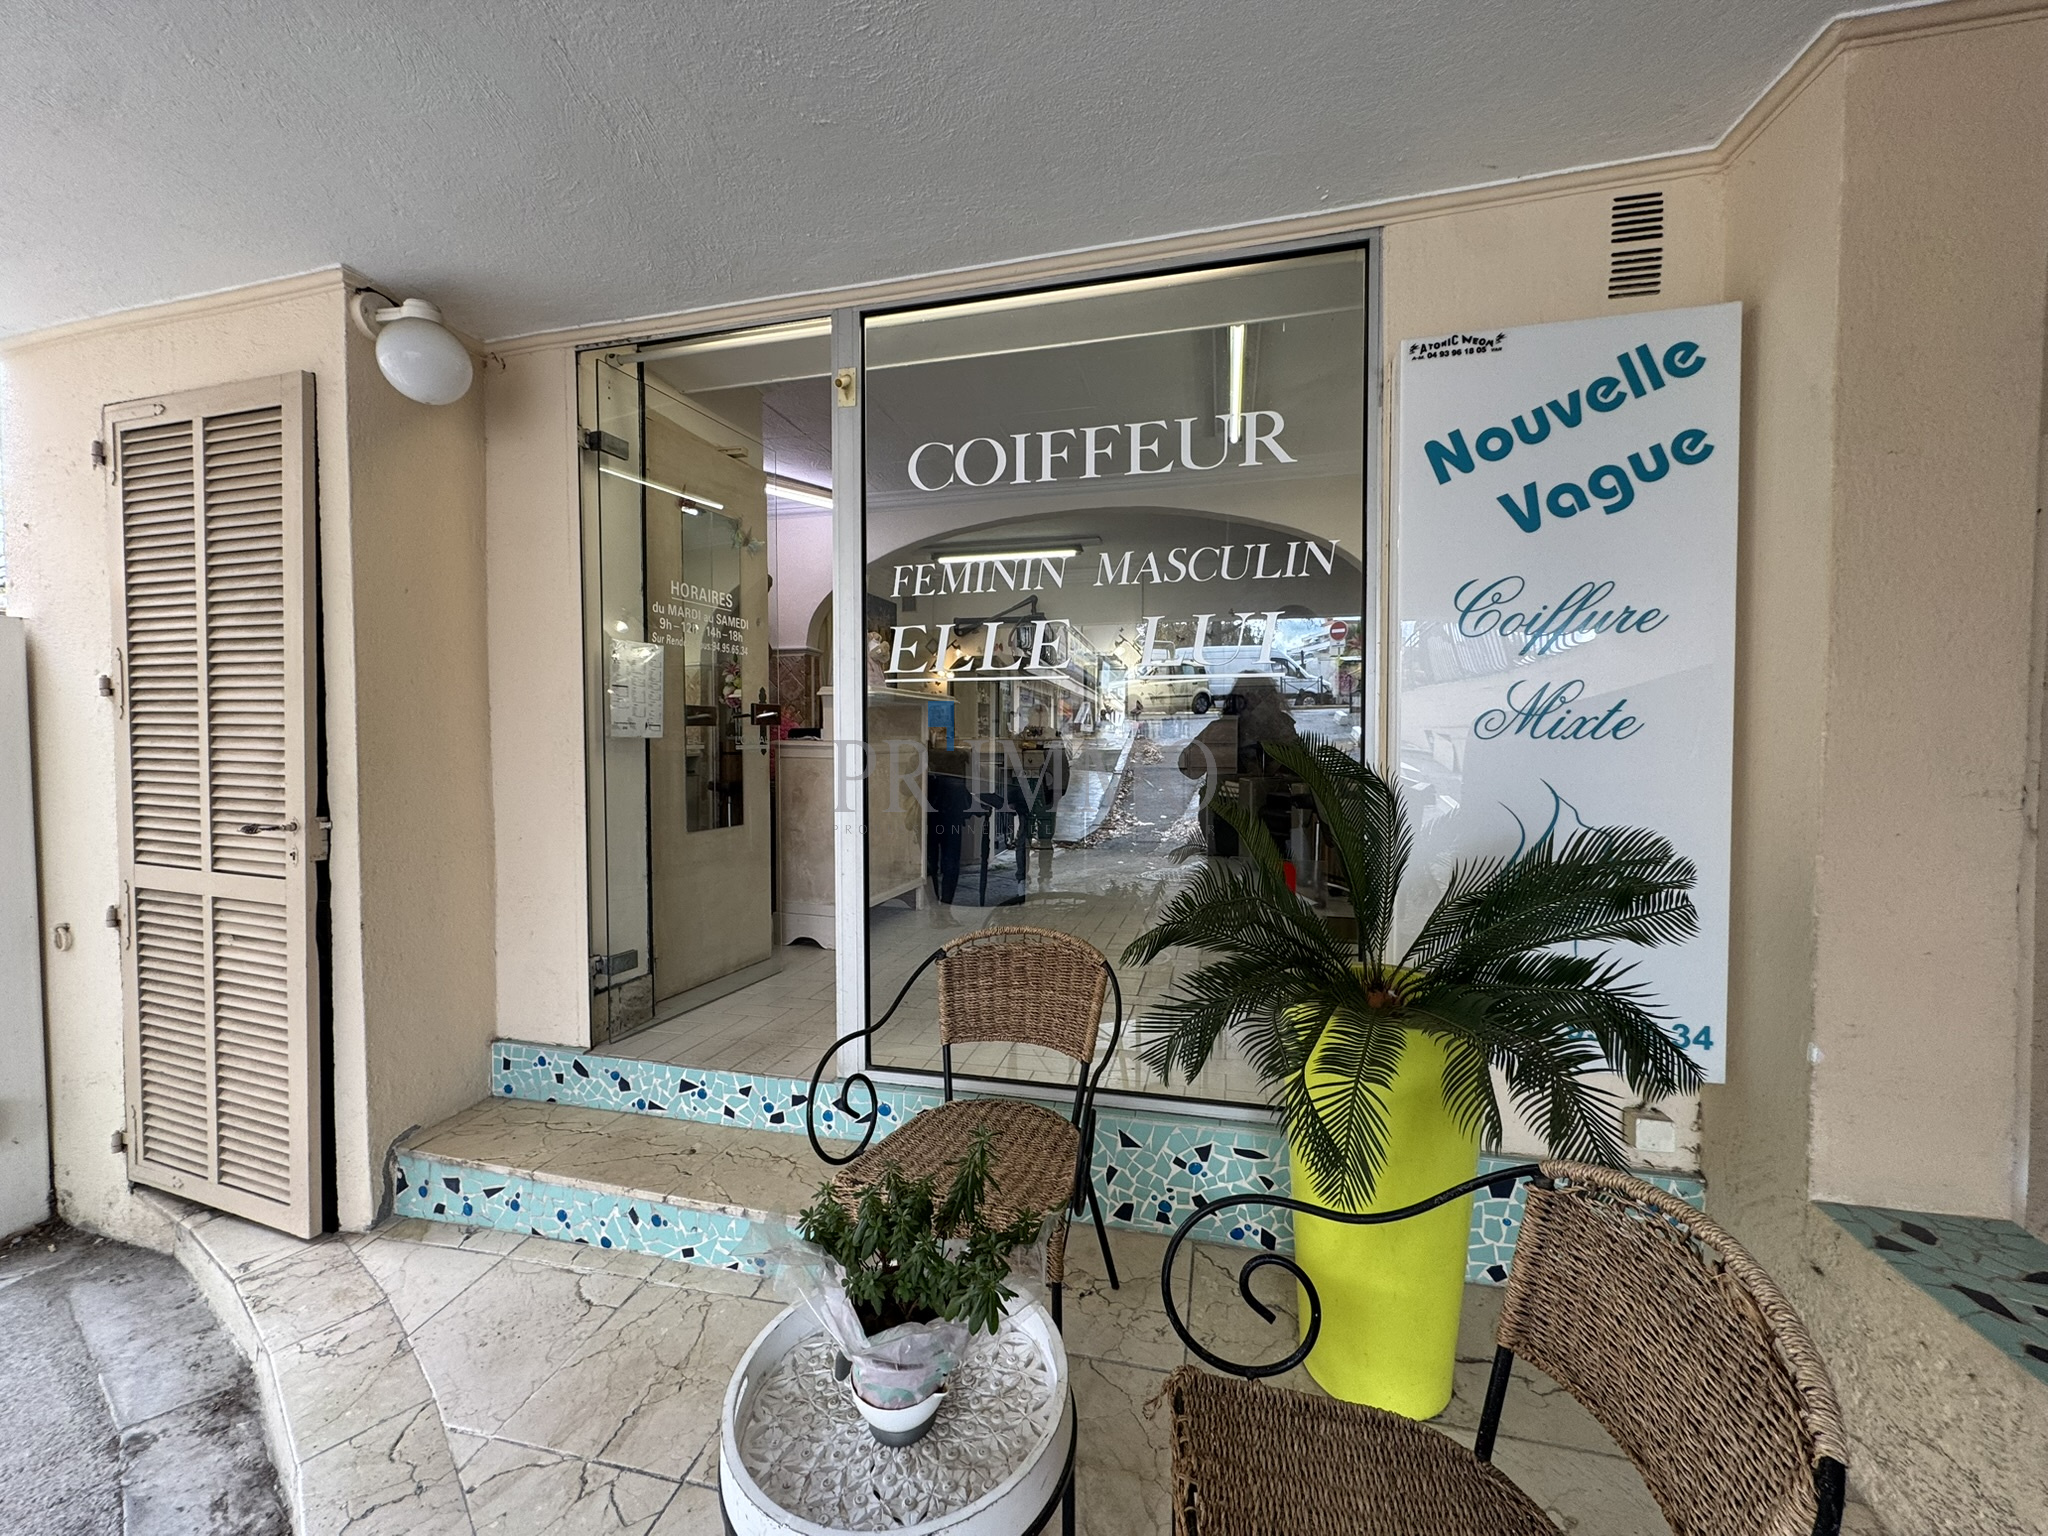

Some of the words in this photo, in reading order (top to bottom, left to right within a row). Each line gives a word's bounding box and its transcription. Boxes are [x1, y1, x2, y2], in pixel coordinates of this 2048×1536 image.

[1420, 335, 1459, 354] ATONIC
[1461, 335, 1494, 347] NEON
[1427, 351, 1438, 359] 04
[1465, 347, 1475, 355] 18
[1424, 341, 1706, 485] Nouvelle
[907, 410, 1298, 492] COIFFEUR
[1496, 428, 1715, 534] Vague
[671, 580, 733, 608] HORAIRES
[890, 556, 1069, 598] FEMININ
[1093, 539, 1340, 587] MASCULIN
[651, 632, 665, 644] Sur
[652, 601, 665, 615] du
[668, 604, 701, 620] MARDI
[716, 614, 749, 630] SAMEDI
[884, 618, 1071, 674] ELLE
[1140, 610, 1286, 667] LUI
[1453, 575, 1669, 656] Coiffure
[1473, 679, 1645, 741] Mixte
[1671, 1023, 1714, 1051] 34
